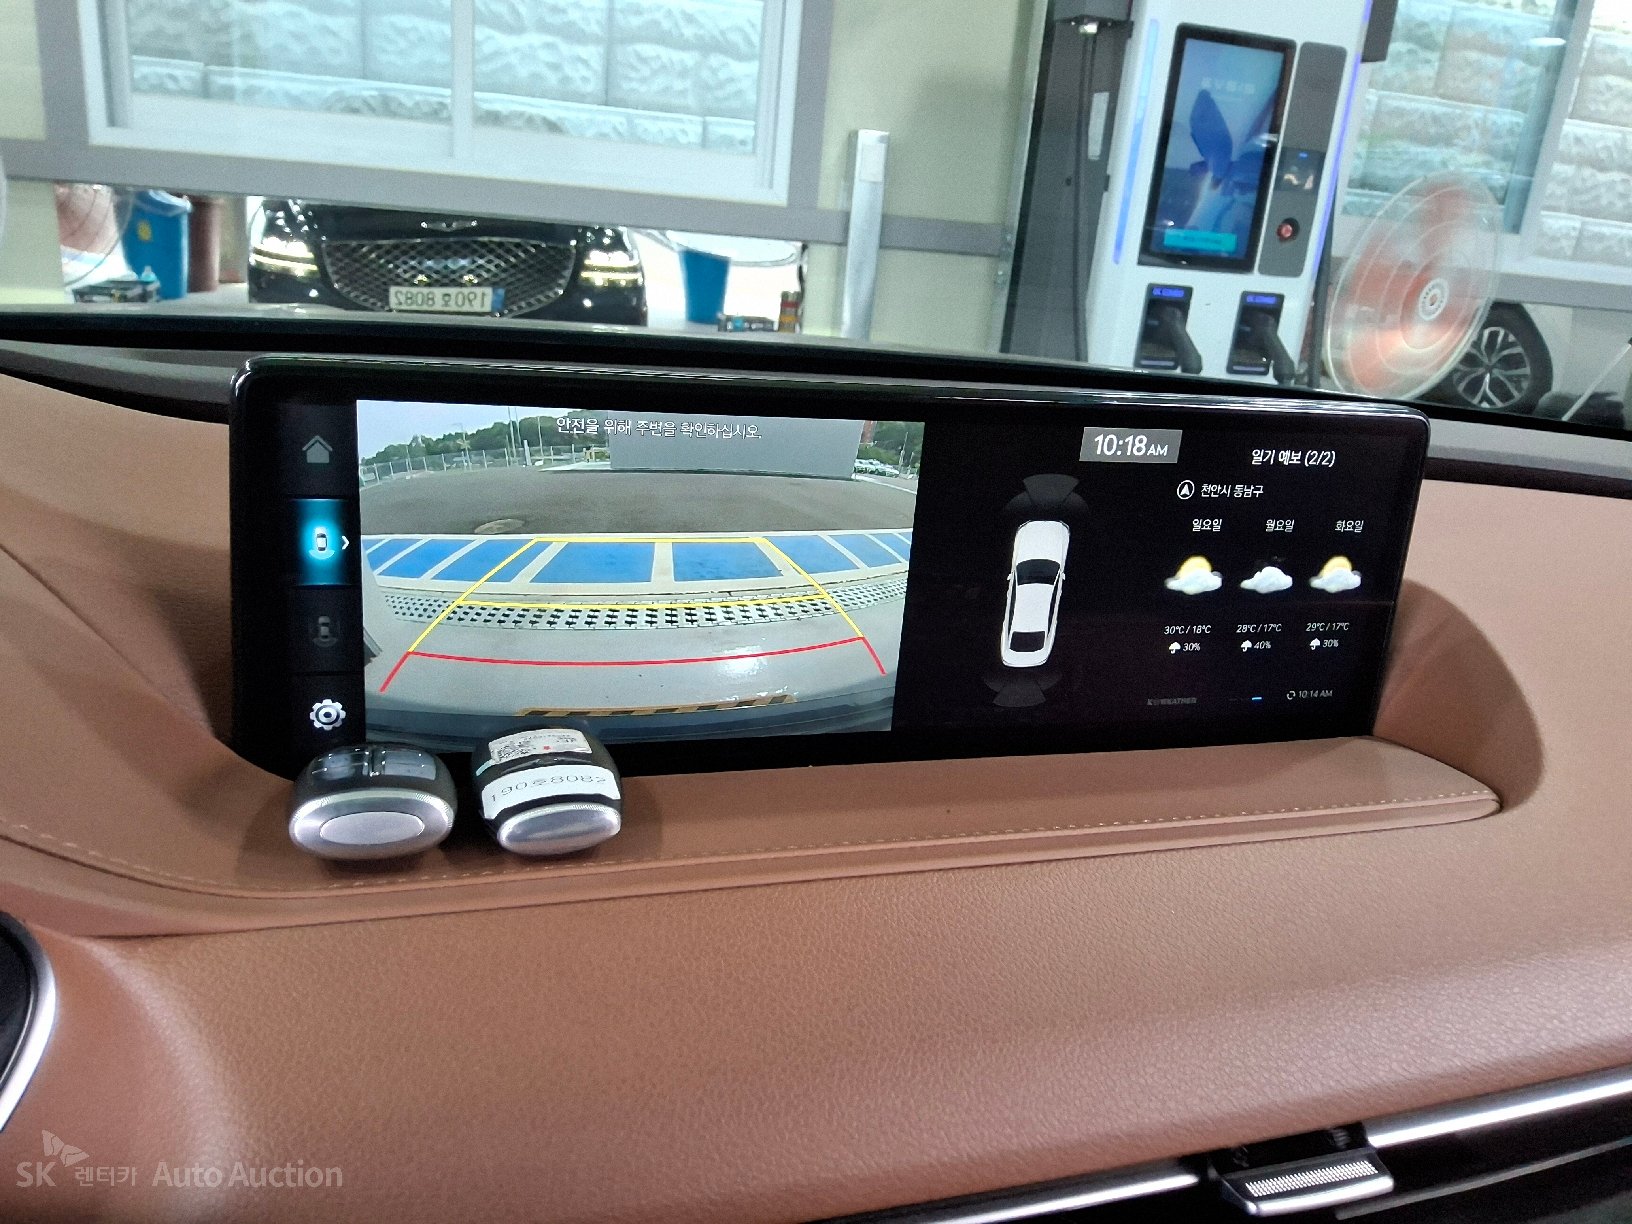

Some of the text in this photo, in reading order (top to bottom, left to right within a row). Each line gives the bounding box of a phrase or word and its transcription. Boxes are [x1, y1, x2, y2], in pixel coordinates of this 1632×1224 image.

[556, 417, 763, 440] 안전을 위해 주변을 확인하십시오.
[1094, 433, 1169, 457] 10:18 AM
[1250, 449, 1336, 468] 일기 예보 (2/2)
[1200, 483, 1264, 499] 천안시 동남구
[1192, 518, 1222, 533] 일요일
[1265, 519, 1295, 534] 월요일
[1334, 520, 1364, 534] 화요일
[1182, 642, 1201, 652] 30%
[1253, 640, 1272, 650] 40%
